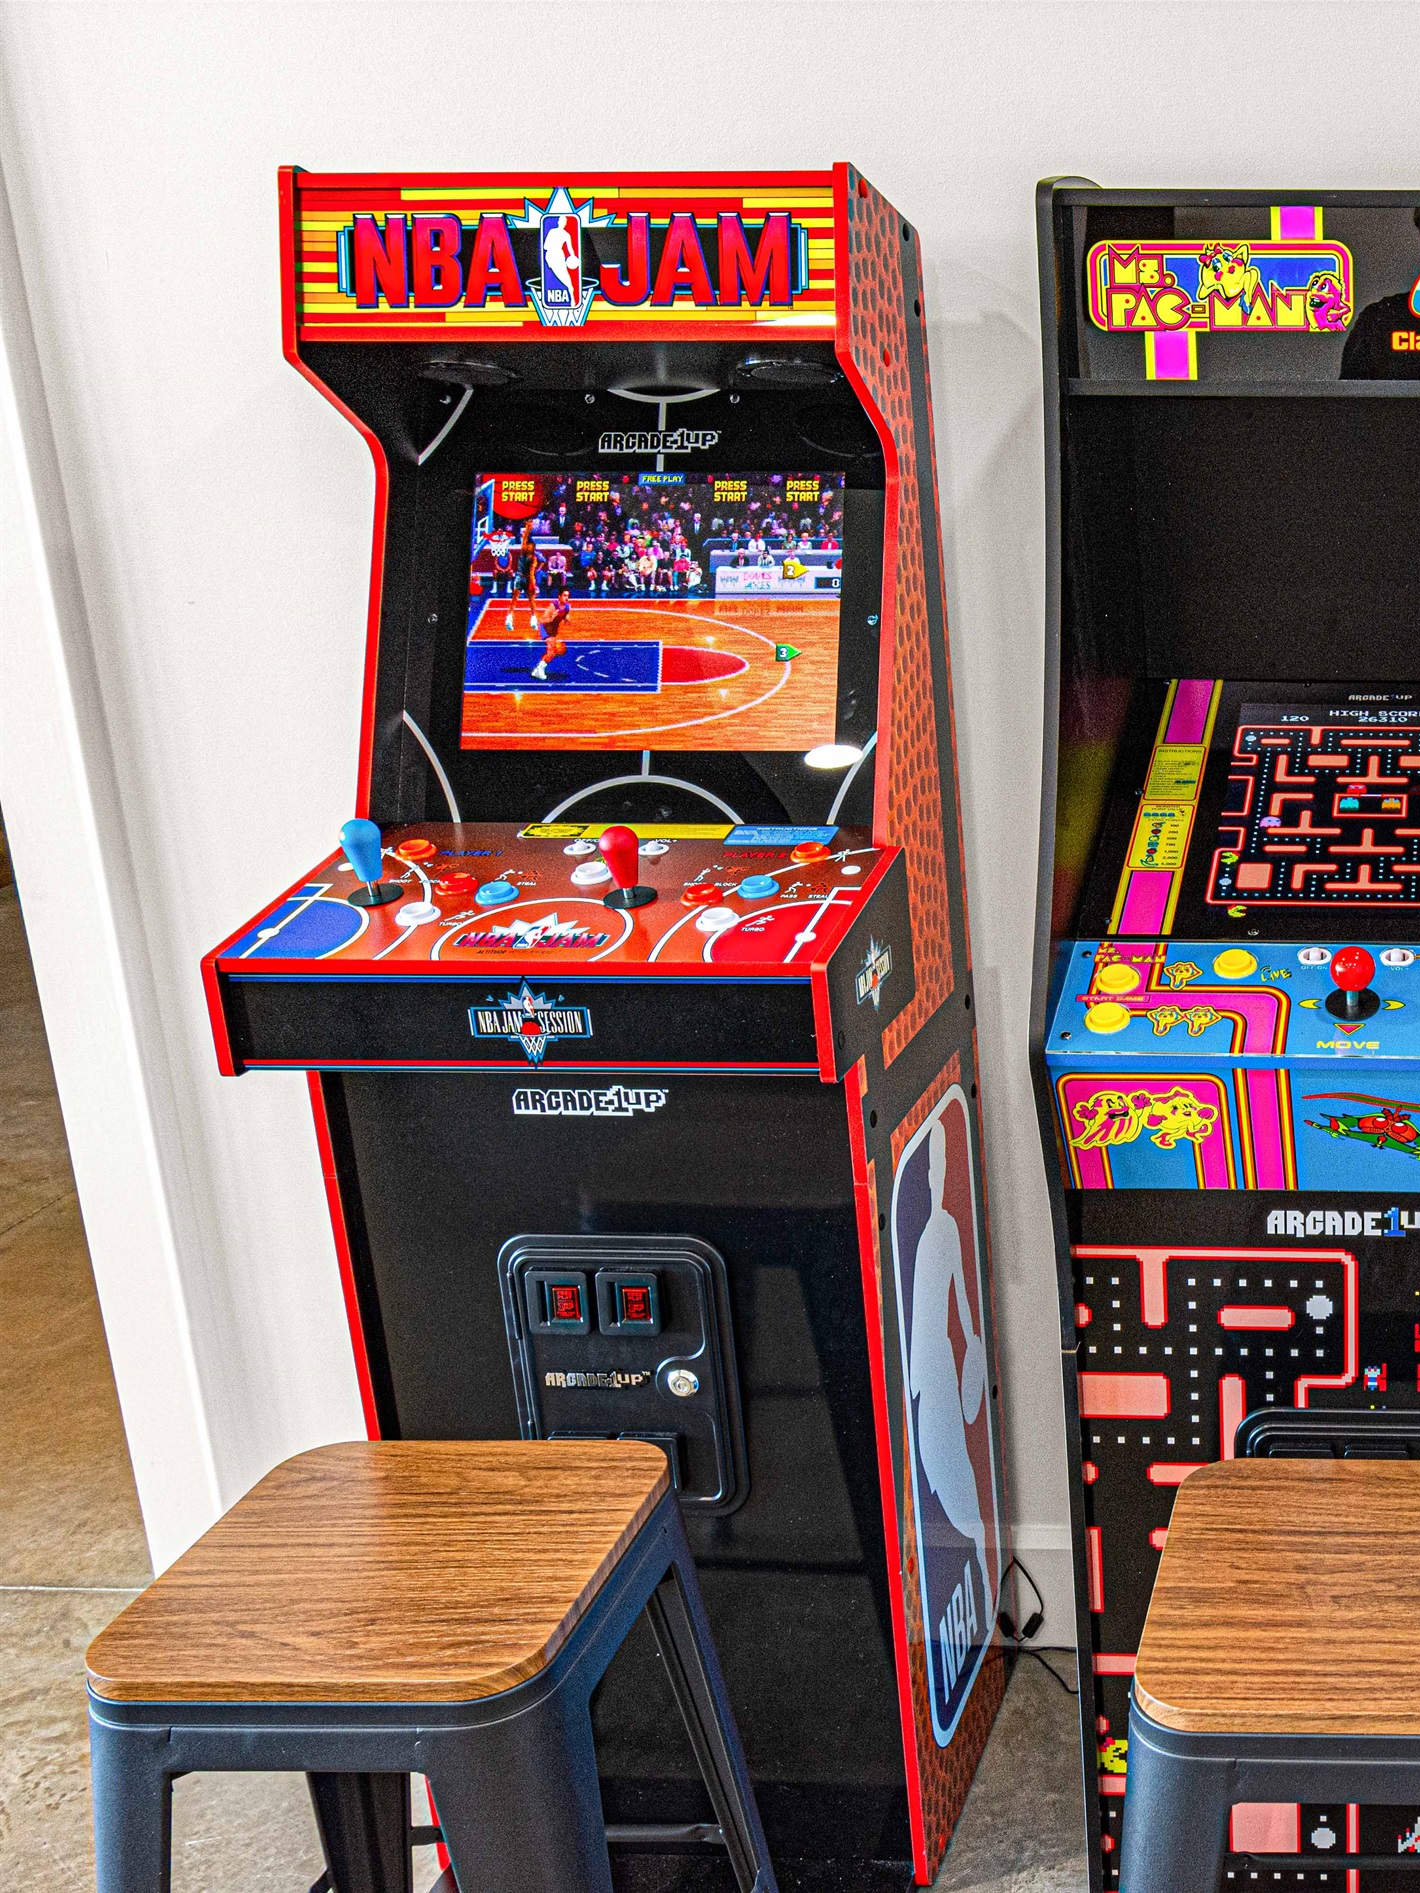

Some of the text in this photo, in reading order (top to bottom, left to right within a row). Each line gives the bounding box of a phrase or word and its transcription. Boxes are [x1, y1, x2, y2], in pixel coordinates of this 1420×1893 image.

[352, 212, 796, 308] NBA JAM
[547, 289, 570, 303] NBA
[1108, 287, 1309, 331] PAC-MAN
[502, 480, 535, 491] PRESS
[576, 480, 610, 491] PRESS
[714, 480, 748, 491] PRESS
[786, 480, 819, 491] PRESS
[501, 491, 535, 502] START
[576, 491, 610, 502] START
[713, 491, 748, 502] START
[786, 491, 819, 502] START
[787, 566, 795, 575] 2
[780, 648, 787, 658] 3
[462, 932, 602, 948] NBA JAM
[1094, 954, 1166, 963] PAC-MAN
[478, 1010, 499, 1033] NBA
[536, 1010, 582, 1033] SESSION
[1316, 1040, 1380, 1049] MOVE
[939, 1559, 978, 1705] NBA
